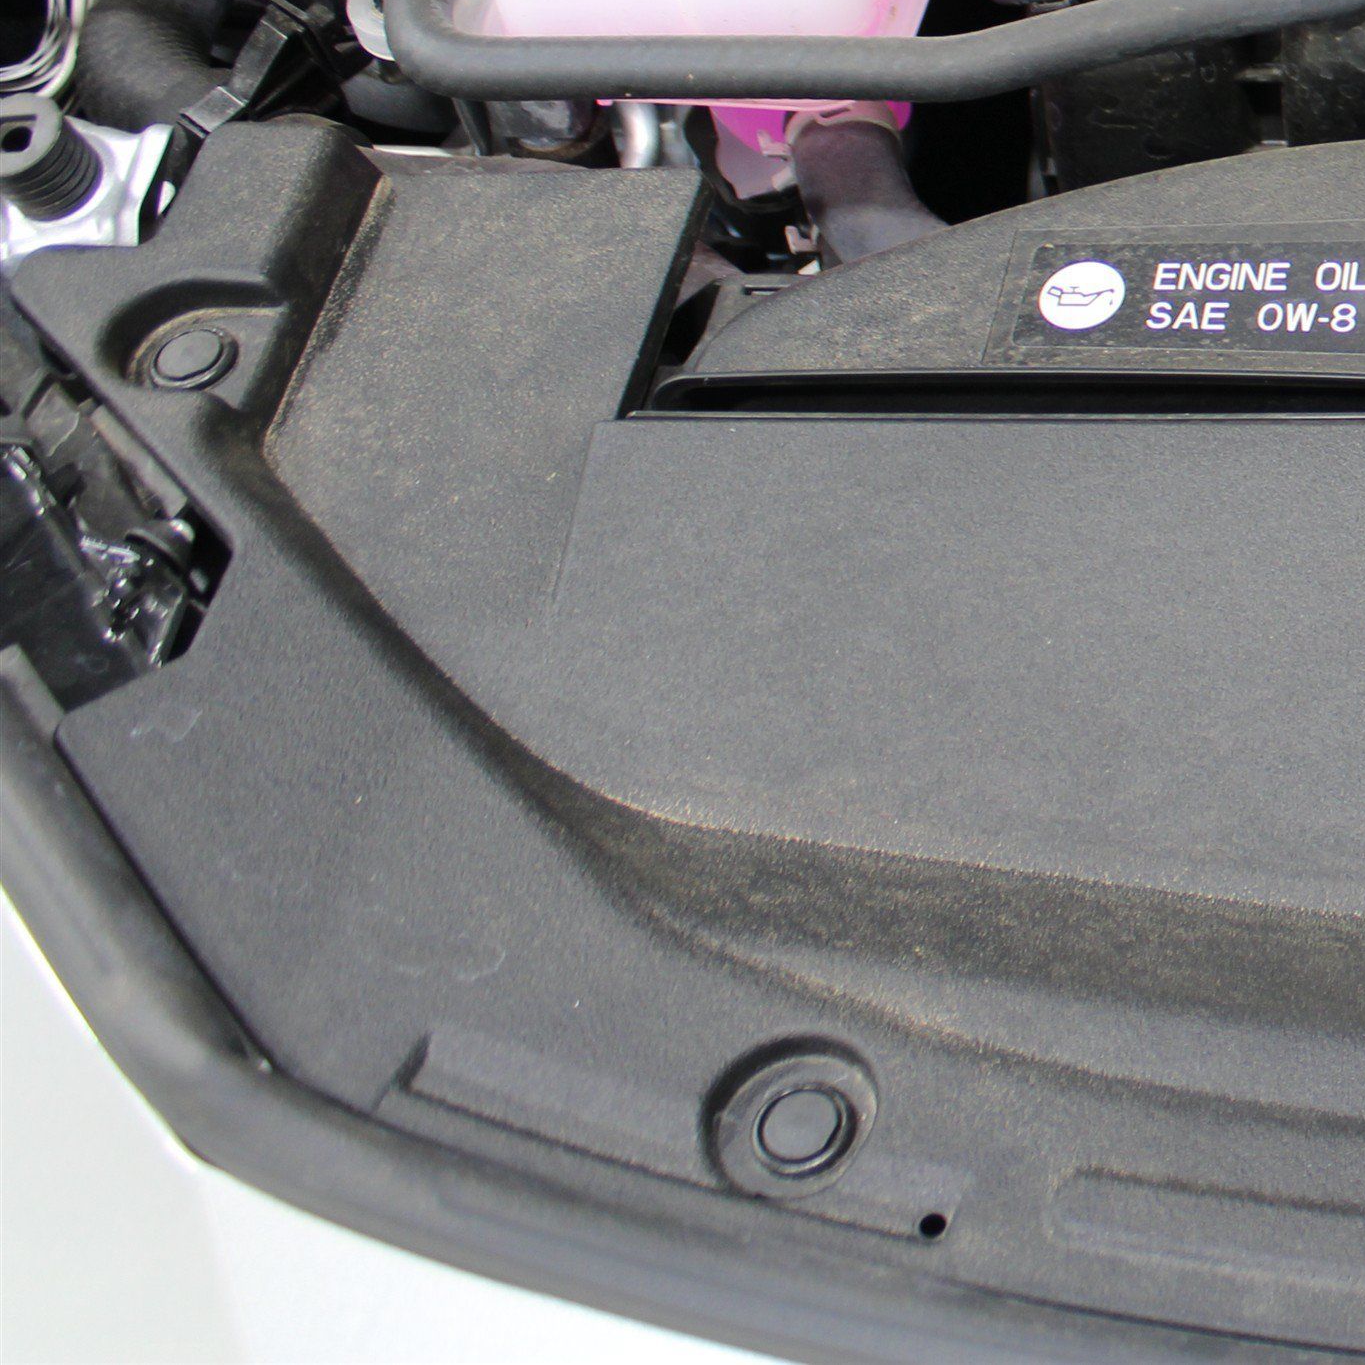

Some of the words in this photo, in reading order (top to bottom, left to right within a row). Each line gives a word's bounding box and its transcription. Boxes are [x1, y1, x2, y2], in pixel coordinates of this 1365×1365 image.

[1153, 262, 1291, 291] ENGINE
[1145, 301, 1230, 330] SAE
[1257, 302, 1357, 333] 0W-8
